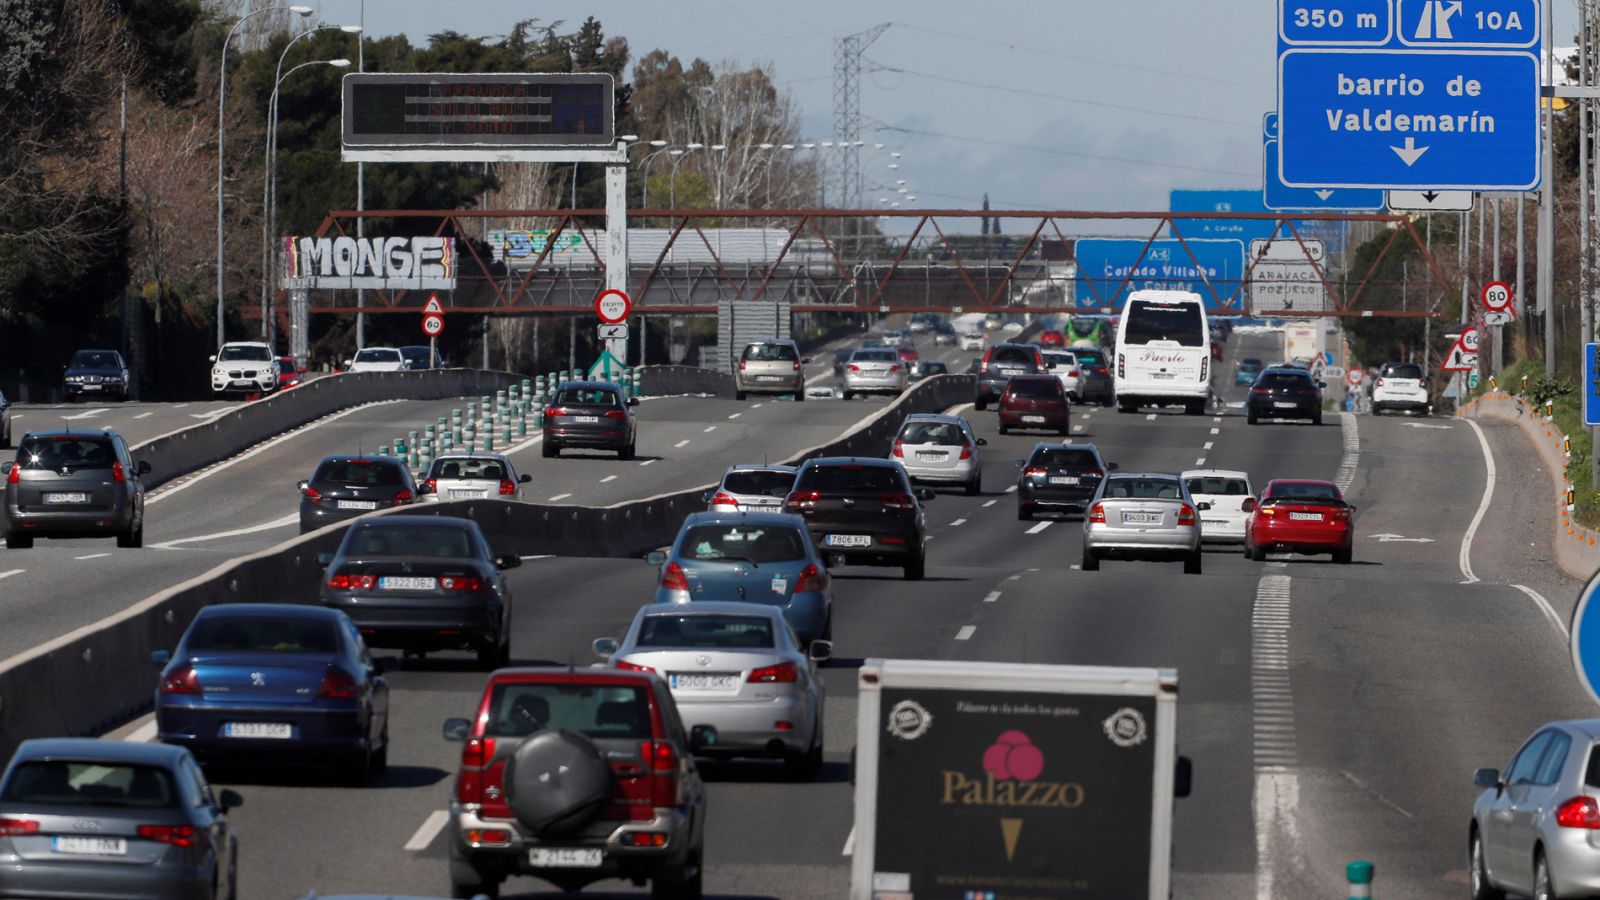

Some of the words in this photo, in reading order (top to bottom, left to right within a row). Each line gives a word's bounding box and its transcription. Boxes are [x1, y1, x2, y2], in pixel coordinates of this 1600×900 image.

[1294, 9, 1343, 28] 350
[1356, 13, 1377, 28] m
[1475, 11, 1521, 30] 10A
[1337, 74, 1424, 96] barrio
[1446, 75, 1481, 96] de
[1326, 107, 1495, 132] Valdemarín
[297, 236, 445, 280] MONGE
[1104, 265, 1156, 276] Collado
[1163, 265, 1217, 276] Villalba
[1258, 271, 1315, 280] ARAVACA
[1258, 285, 1315, 294] POZUELO
[1489, 291, 1505, 302] 80
[1466, 336, 1478, 344] 60
[832, 536, 852, 544] 7806
[942, 770, 1084, 808] Palazzo
